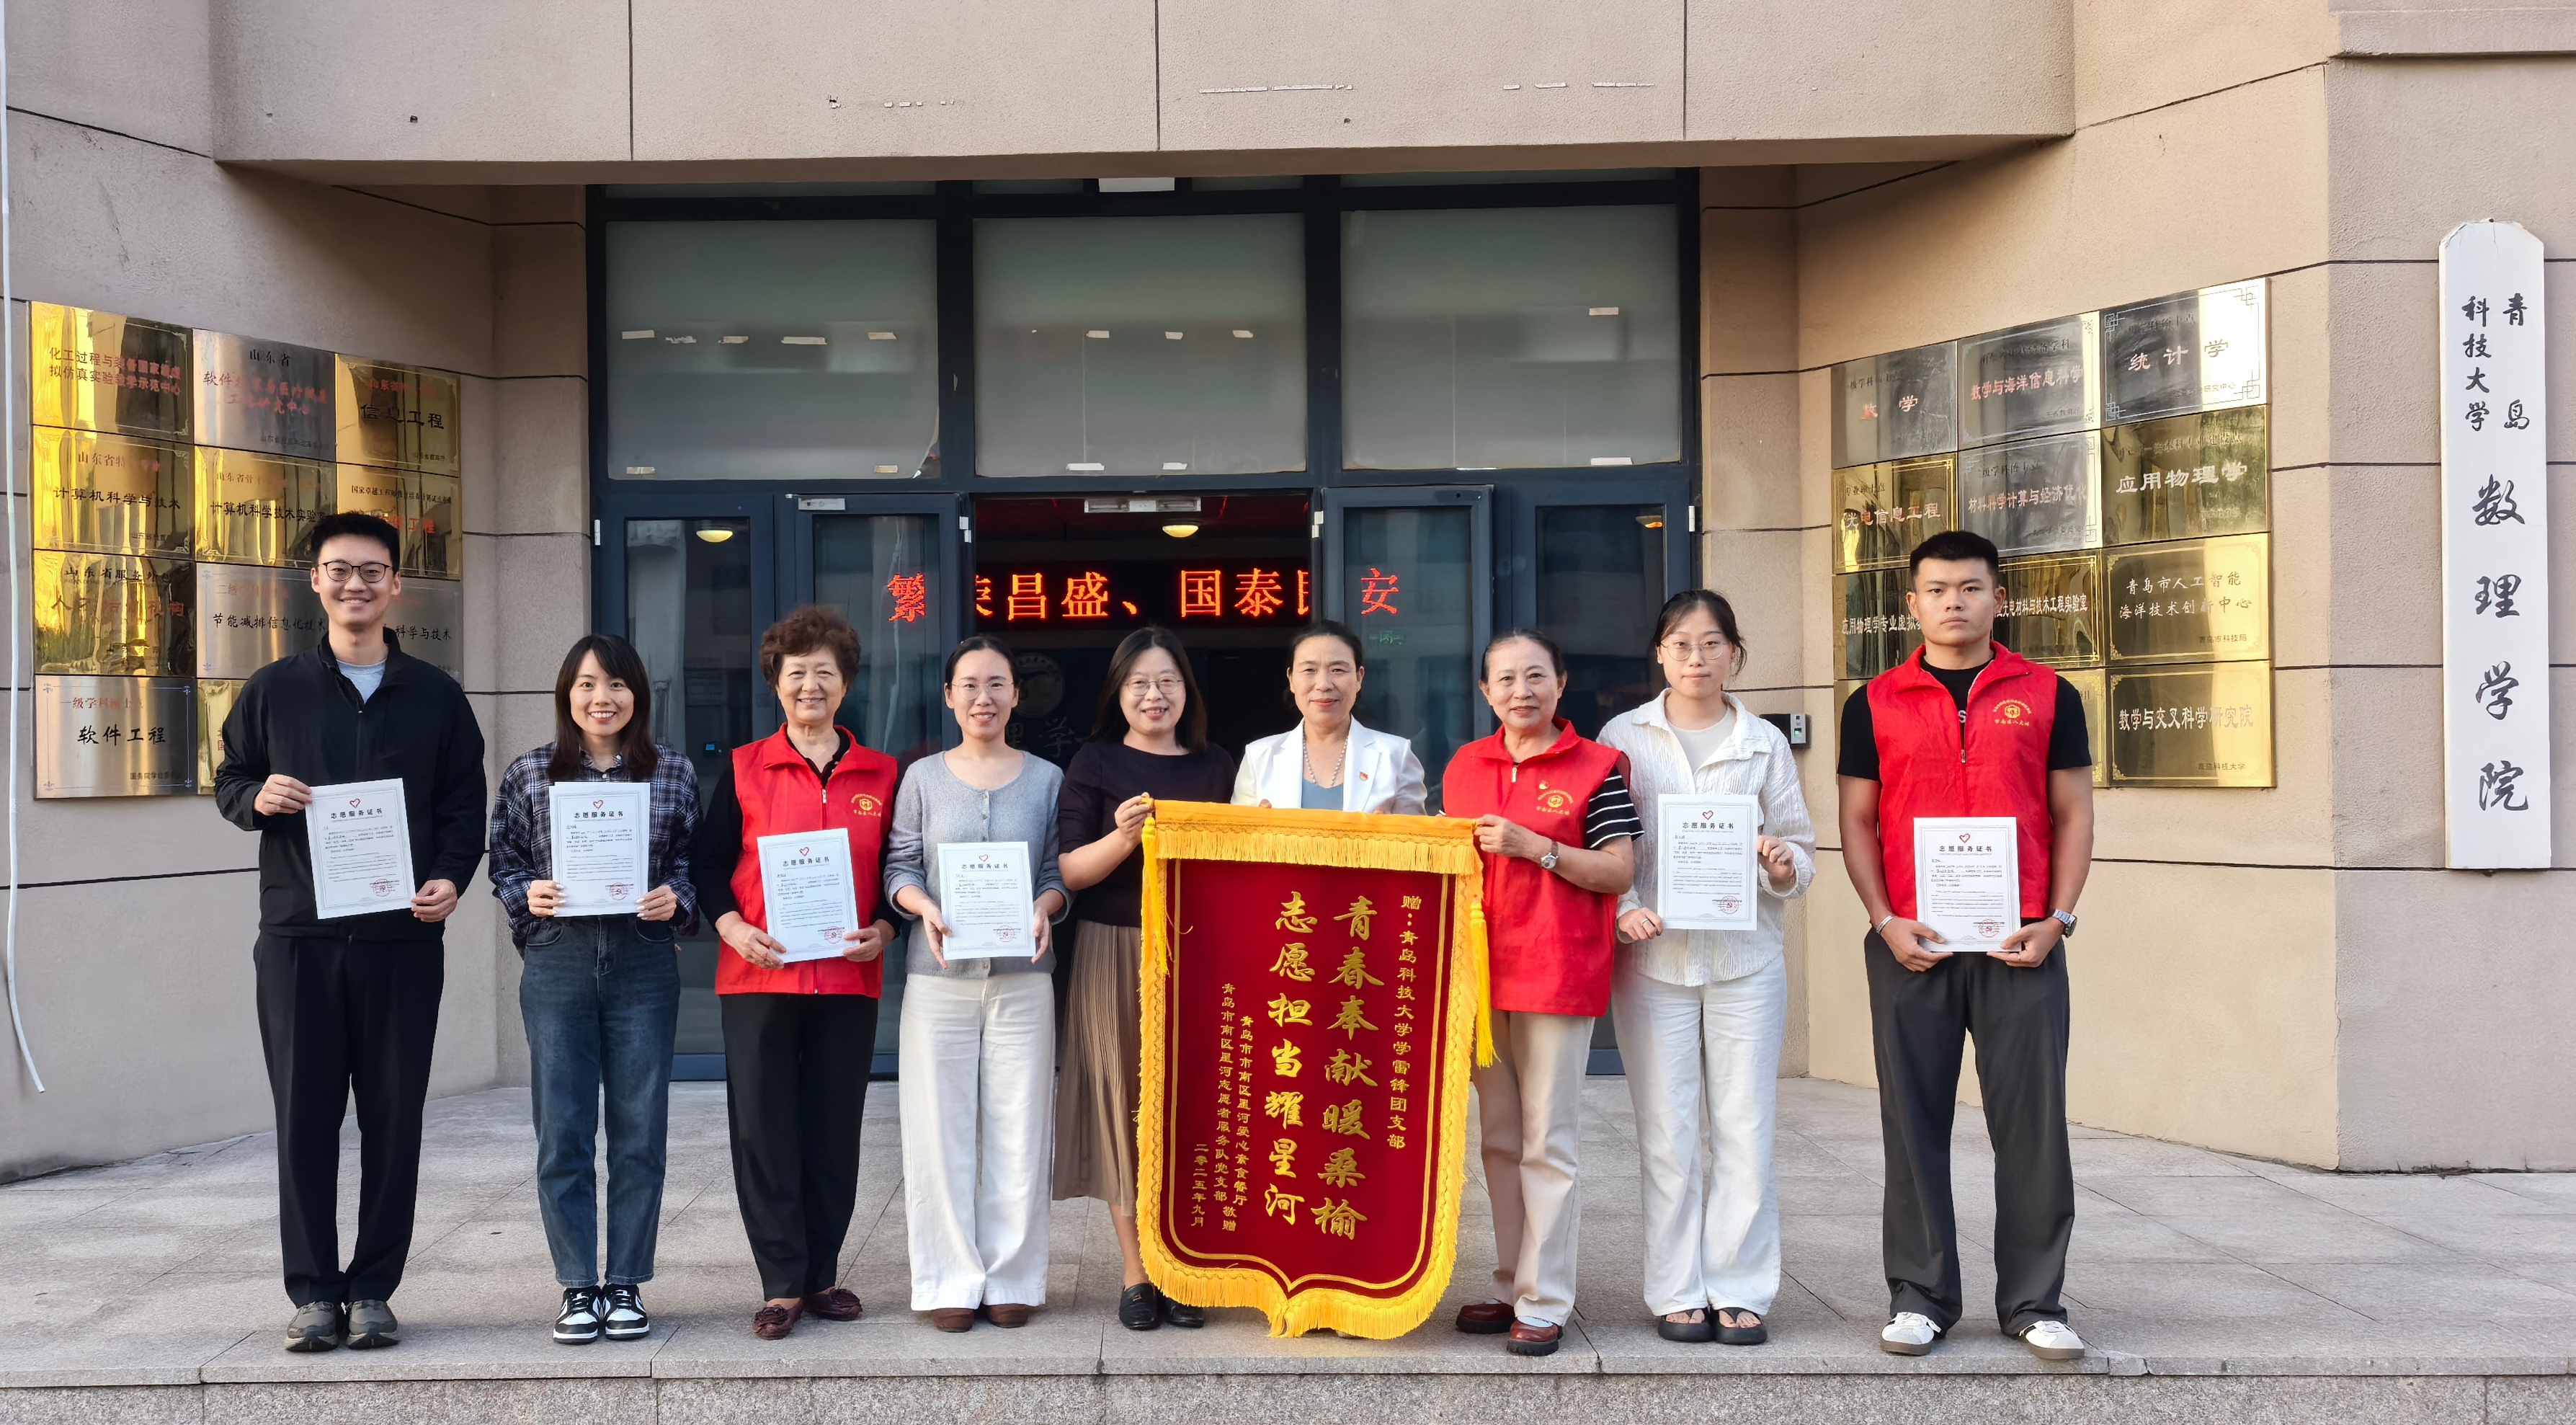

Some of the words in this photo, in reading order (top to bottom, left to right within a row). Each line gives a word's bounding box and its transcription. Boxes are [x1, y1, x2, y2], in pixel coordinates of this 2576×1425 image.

[2128, 338, 2229, 371] 统计学
[2461, 295, 2492, 432] 科技大学
[2503, 293, 2531, 430] 青岛
[1971, 365, 2083, 401] 数学与海洋信息科学
[360, 404, 445, 430] 信息工程
[2116, 458, 2247, 494] 应用物理学
[53, 487, 180, 509] 计算机科学与技术
[1846, 502, 1941, 528] 光电信息工程
[2126, 571, 2242, 595] 青岛市人工智能
[2119, 596, 2252, 619] 海洋技术创新中心
[2473, 474, 2529, 812] 数理学院
[2118, 703, 2253, 732] 数学与交叉科学研究院
[76, 724, 166, 746] 软件工程
[1264, 891, 1318, 1225] 志愿担当耀星河
[1310, 895, 1385, 1240] 青春奉献暖桑榆
[1190, 1143, 1210, 1228] 二零二五年九月
